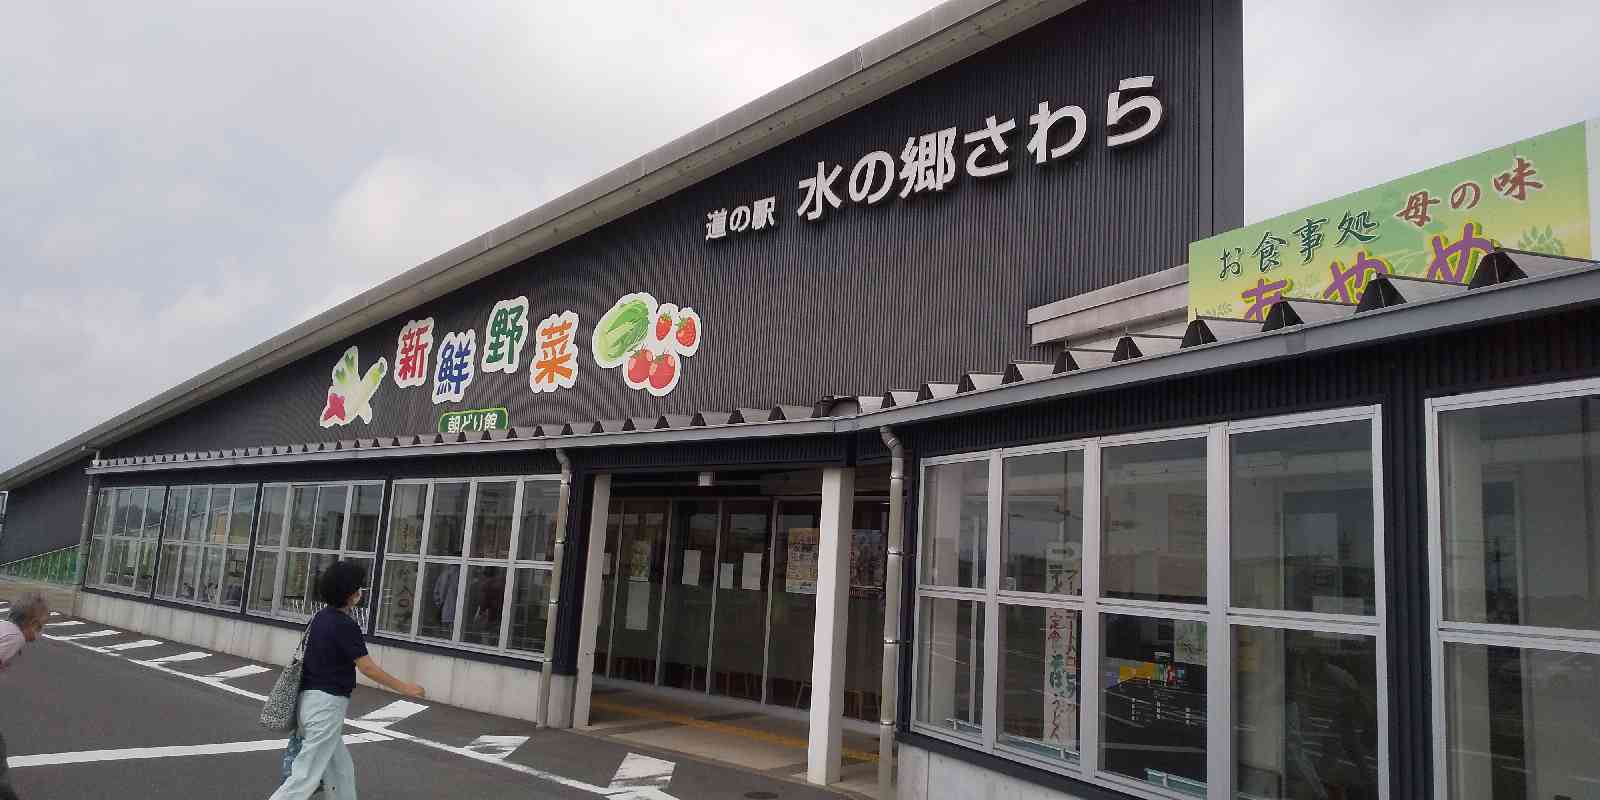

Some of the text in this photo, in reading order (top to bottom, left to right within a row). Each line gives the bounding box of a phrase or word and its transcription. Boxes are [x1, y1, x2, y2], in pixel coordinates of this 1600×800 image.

[705, 76, 1163, 240] 道の駅 水の郷さわら
[1219, 157, 1543, 279] お食事処 母の味
[398, 305, 573, 395] 新鮮野菜
[447, 413, 498, 433] 朝どり館
